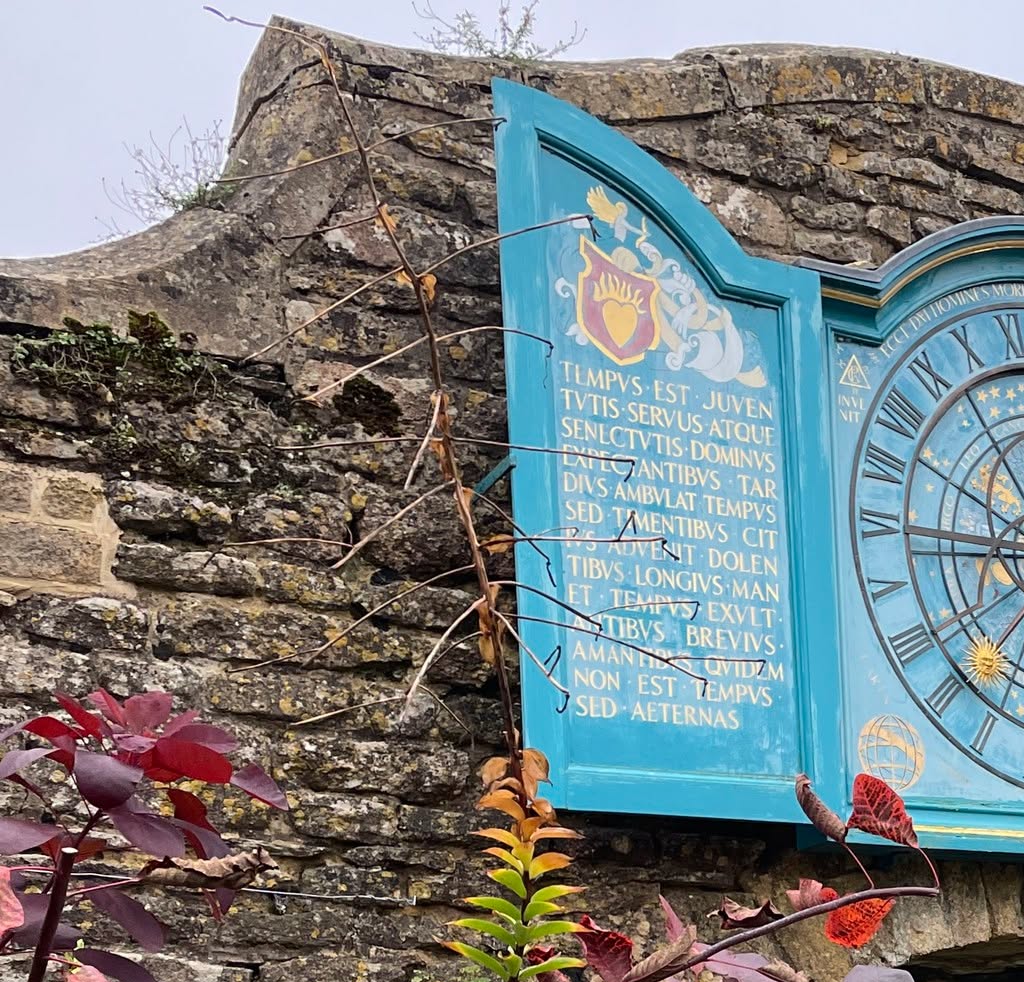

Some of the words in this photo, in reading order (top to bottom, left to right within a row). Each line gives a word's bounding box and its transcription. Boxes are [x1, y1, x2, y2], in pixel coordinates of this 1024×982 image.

[948, 323, 985, 374] X
[907, 349, 953, 402] IX
[560, 388, 620, 419] TVTIS
[627, 402, 703, 434] SERVUS
[653, 379, 691, 406] EST
[702, 391, 773, 421] JUVEN
[690, 439, 777, 473] DOMINVS
[563, 471, 609, 498] DIVS
[613, 481, 698, 512] AMBVLAT
[702, 494, 777, 524] TEMPVS
[737, 474, 779, 500] TAR
[565, 501, 604, 524] SED
[741, 527, 779, 550] CIT
[566, 554, 625, 583] TIBVS
[634, 564, 724, 596] LONGIVS
[731, 579, 780, 603] MAN
[708, 548, 779, 577] DOLEN
[567, 583, 593, 607] ET
[707, 601, 777, 629] EXVLT
[867, 576, 909, 603] V
[685, 624, 777, 656] BREVIVS
[573, 669, 621, 691] NON
[638, 674, 677, 698] EST
[691, 681, 773, 708] TEMPVS
[575, 695, 617, 719] SED
[630, 701, 741, 730] AETERNAS
